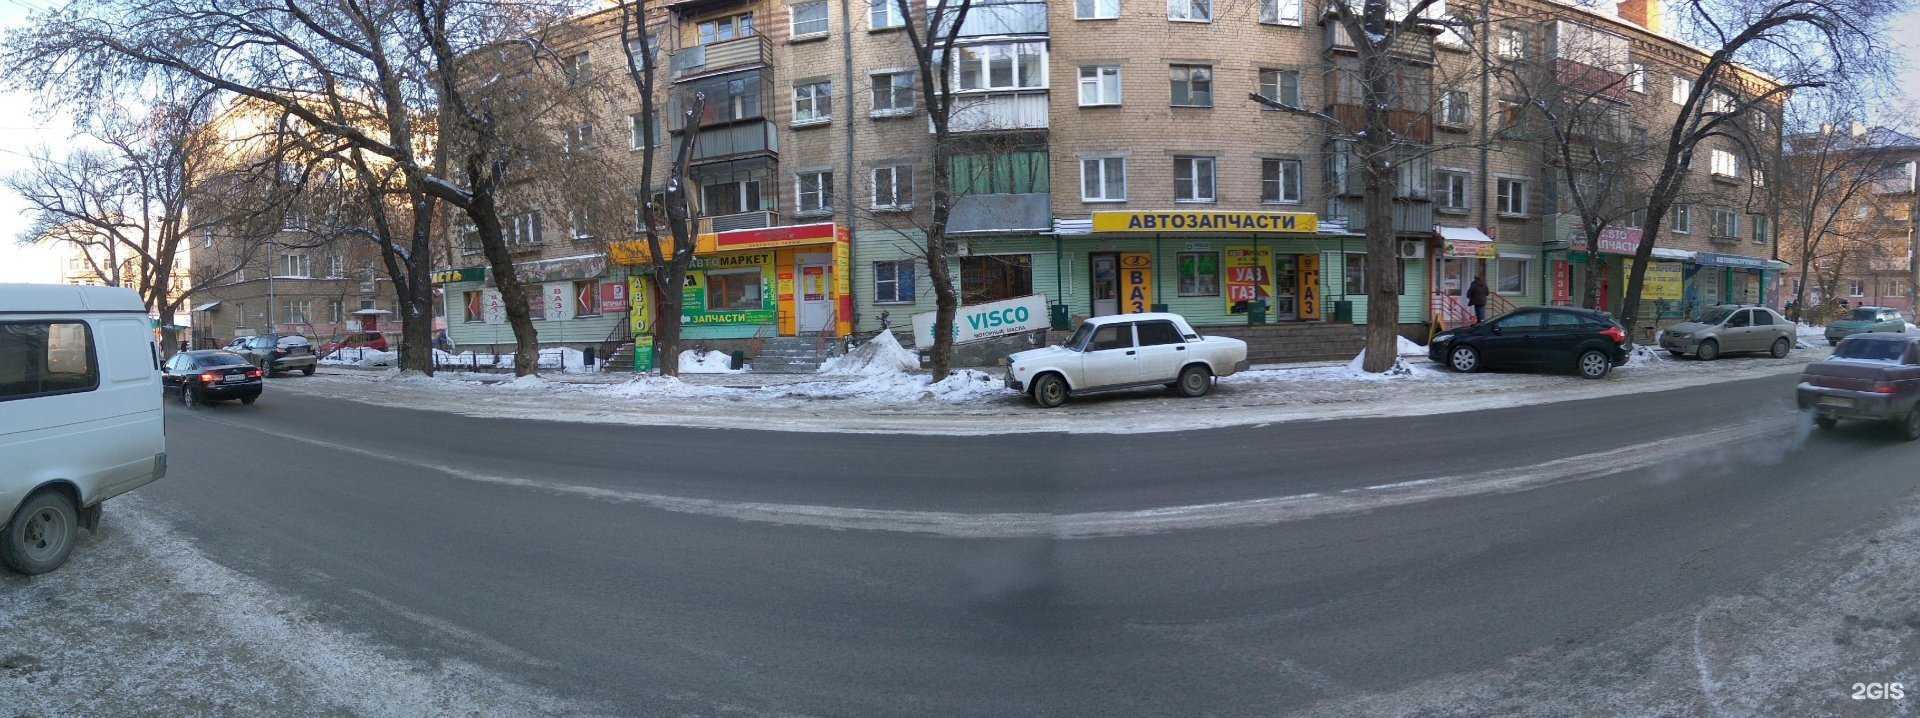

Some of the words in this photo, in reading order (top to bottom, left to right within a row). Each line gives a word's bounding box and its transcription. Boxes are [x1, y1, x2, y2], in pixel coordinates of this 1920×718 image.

[1128, 214, 1296, 229] АВТОЗАПЧАСТИ
[1236, 267, 1262, 282] УАЗ
[1130, 271, 1144, 313] ВАЗ
[1231, 285, 1256, 300] ГАЗ
[1304, 272, 1313, 314] ГАЗ
[635, 278, 645, 330] АВТО
[694, 313, 746, 325] ЗАПЧАСТИ
[967, 306, 1029, 330] VISCO
